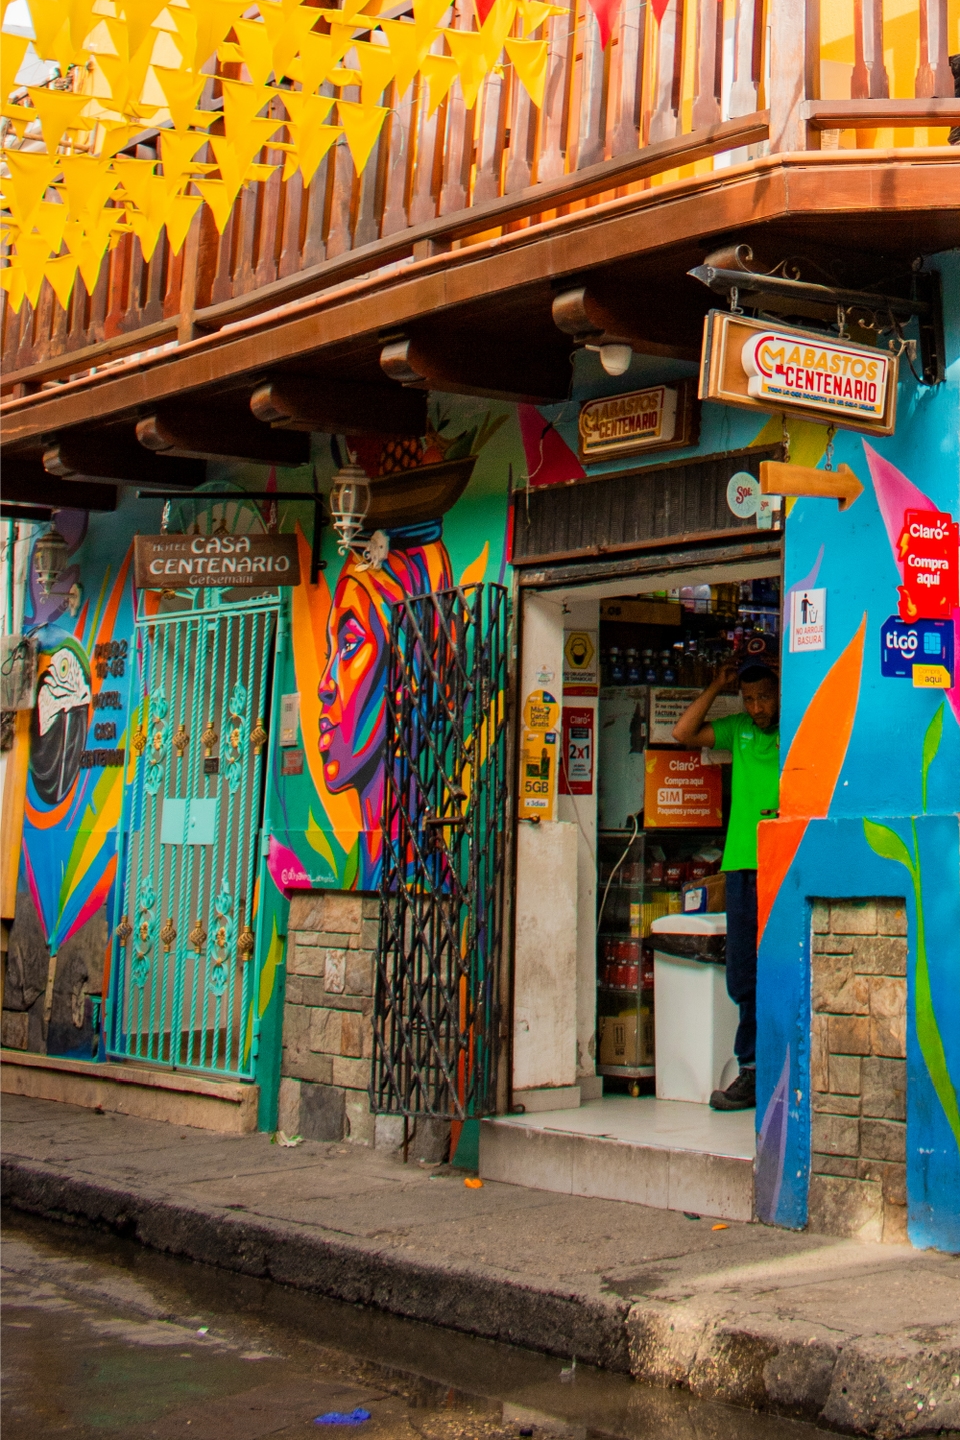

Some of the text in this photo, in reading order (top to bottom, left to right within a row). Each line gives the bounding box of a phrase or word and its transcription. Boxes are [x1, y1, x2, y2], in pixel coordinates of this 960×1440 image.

[786, 346, 878, 381] ABASTOS
[785, 366, 877, 403] CENTENARIO
[600, 393, 659, 420] ABASTOS
[599, 411, 658, 439] CENTENARIO
[910, 522, 944, 539] Claro
[190, 536, 251, 554] CASA
[149, 555, 290, 575] CENTENARIO
[907, 554, 949, 571] Compra
[917, 571, 940, 588] aquí
[796, 625, 823, 635] NO ARROJE
[797, 635, 822, 645] BASURA
[924, 674, 943, 685] aquí
[569, 715, 588, 724] Claro
[569, 744, 590, 759] 2x1
[669, 760, 696, 771] Claro
[525, 781, 549, 793] 5GB
[664, 776, 704, 787] Compra aquí
[659, 791, 708, 802] SIM prepago
[657, 807, 683, 816] Paquetes
[687, 808, 711, 816] recargas
